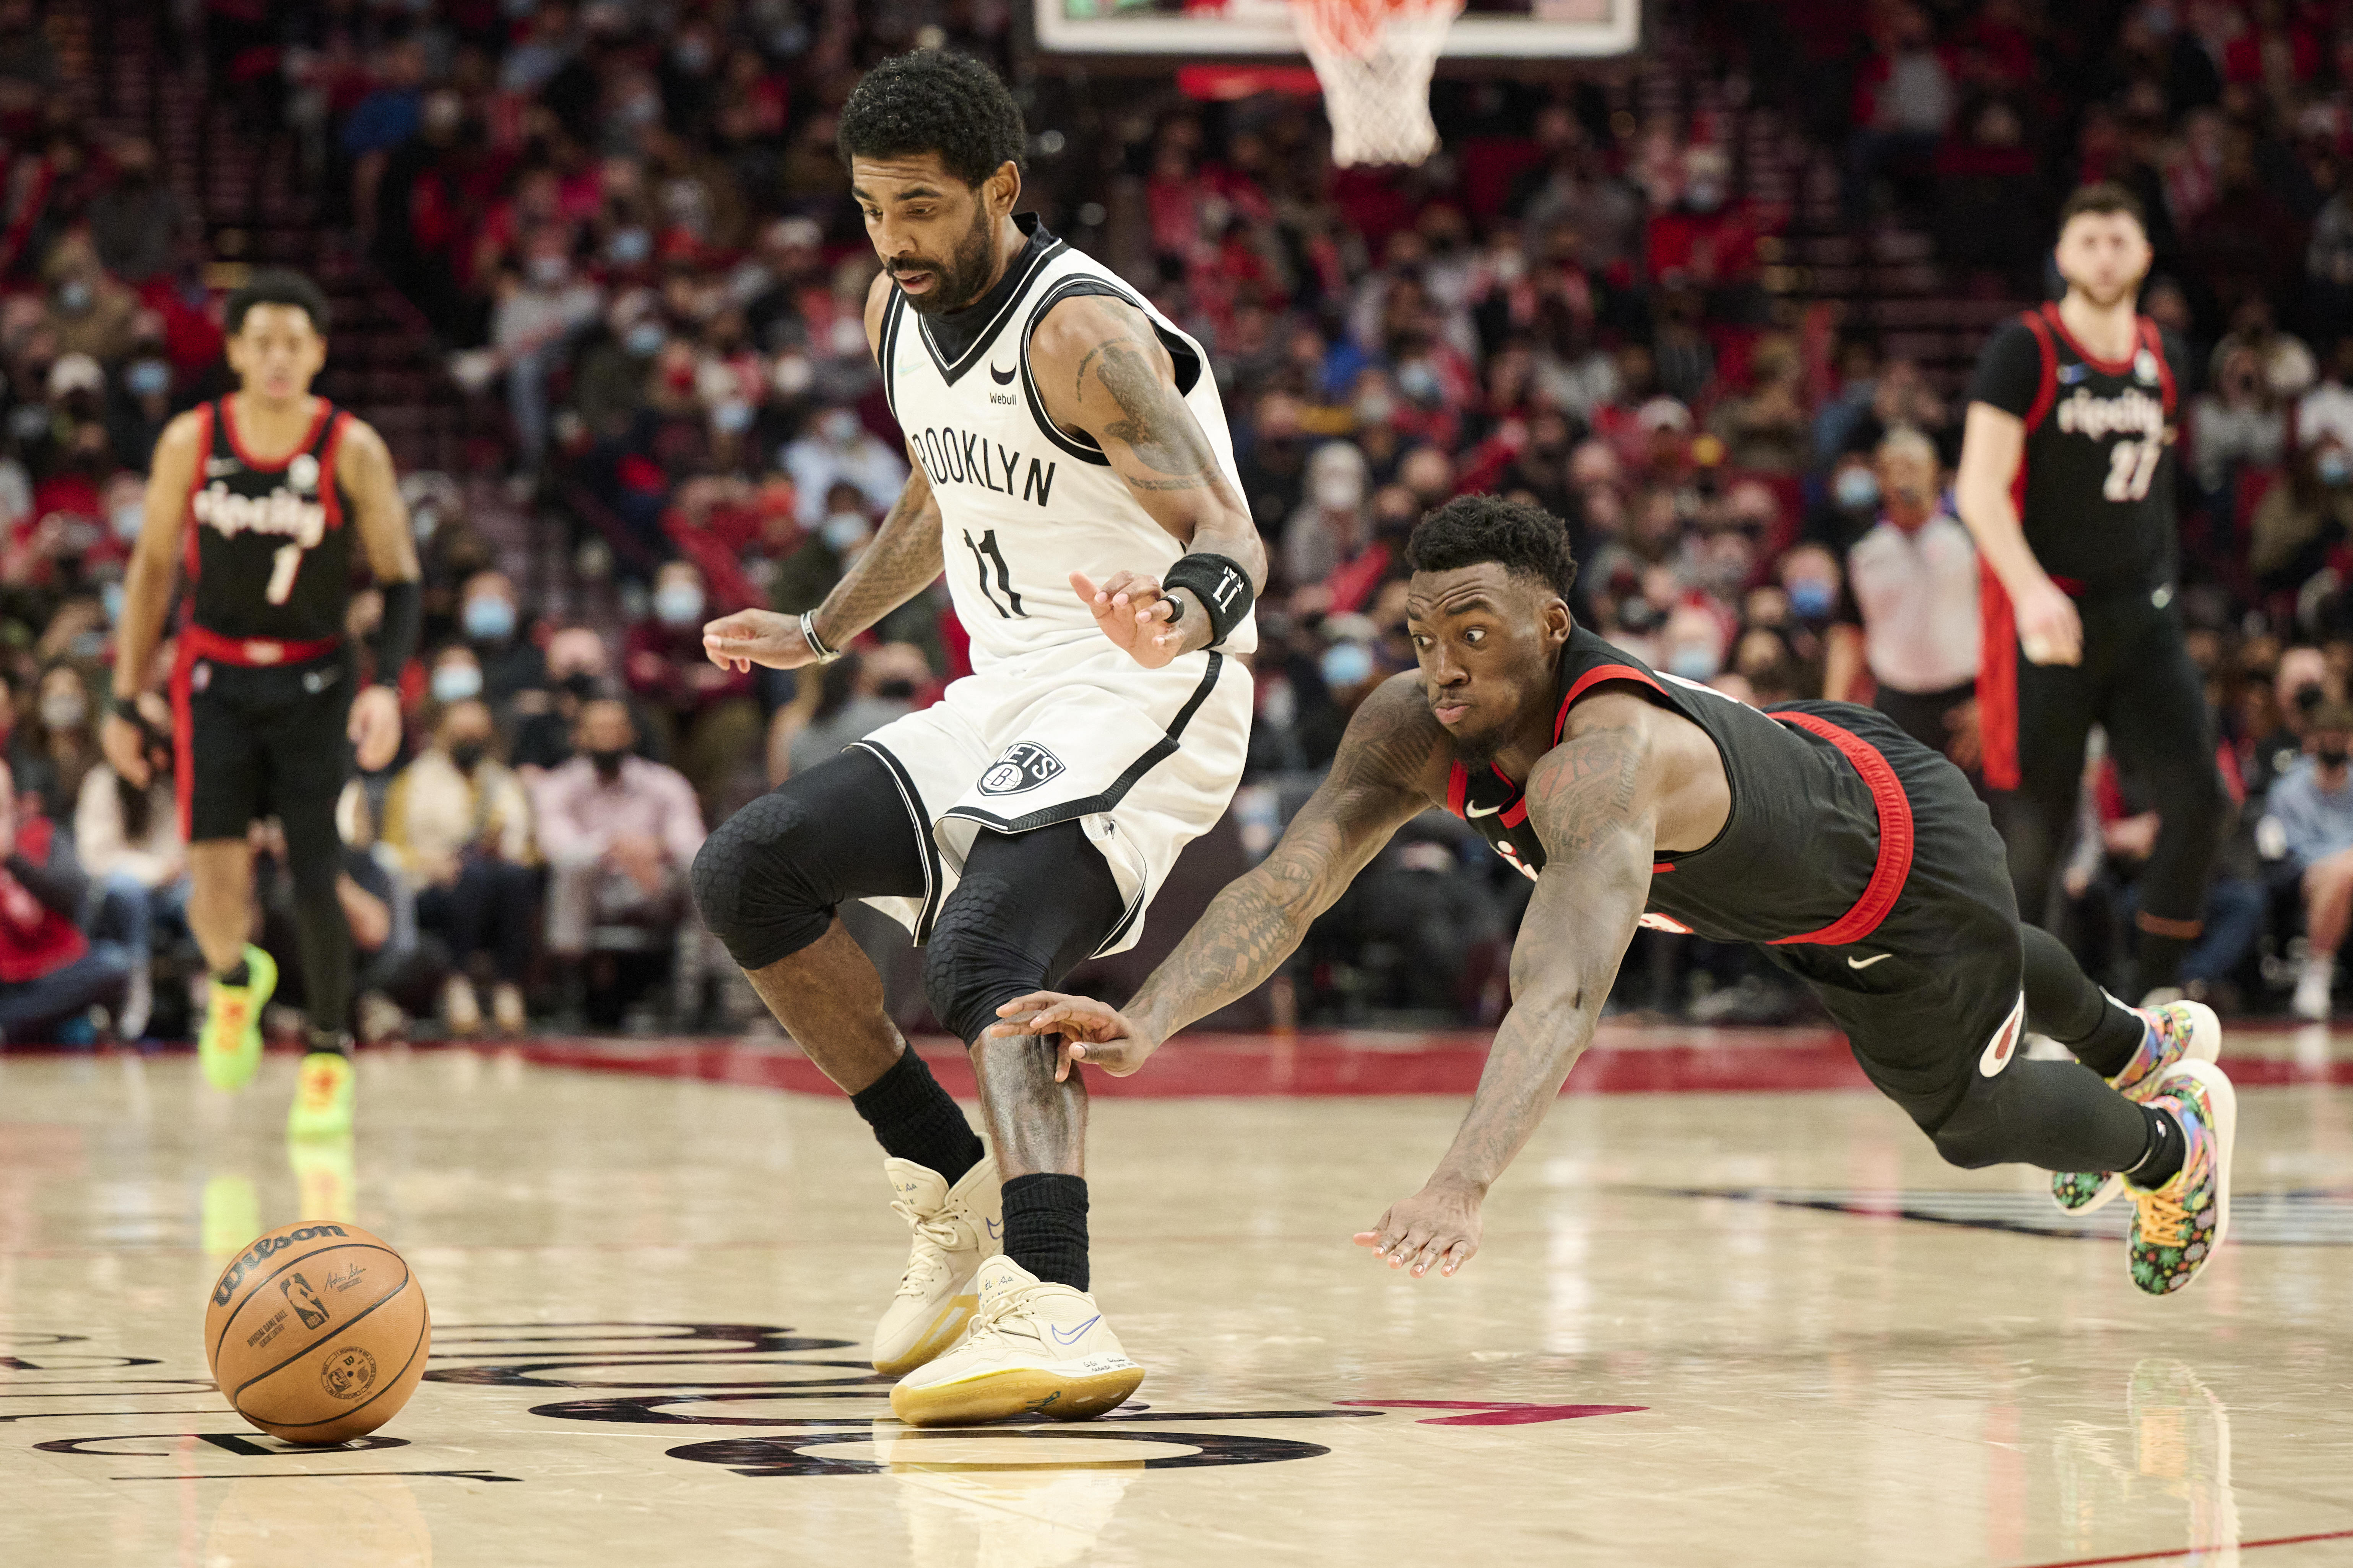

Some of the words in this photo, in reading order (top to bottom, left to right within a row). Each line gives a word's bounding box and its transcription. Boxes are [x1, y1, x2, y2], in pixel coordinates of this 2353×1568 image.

[990, 392, 1017, 406] Webull
[912, 427, 1056, 507] ROOKLYN
[2103, 440, 2163, 502] 27
[266, 542, 303, 606] 1
[962, 528, 1030, 618] 11
[990, 767, 1013, 786] B
[213, 1225, 349, 1307] Wilson
[274, 1309, 288, 1323] BALL
